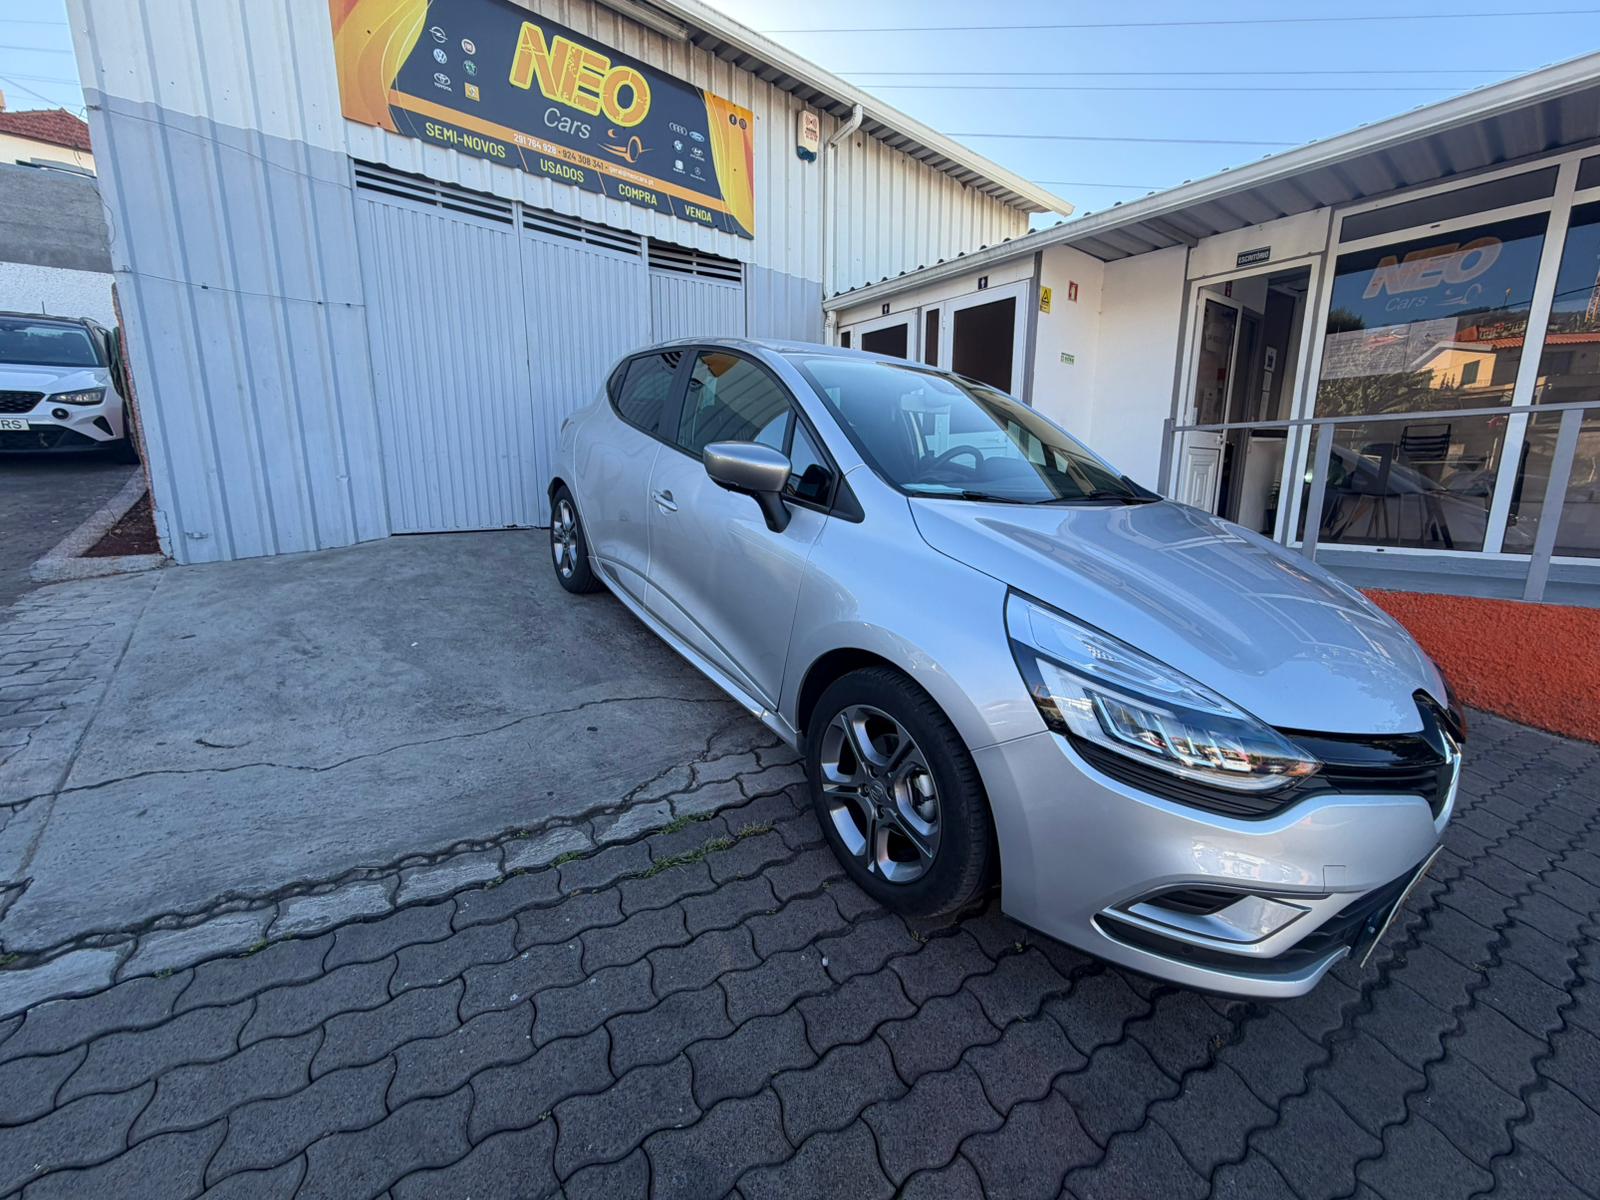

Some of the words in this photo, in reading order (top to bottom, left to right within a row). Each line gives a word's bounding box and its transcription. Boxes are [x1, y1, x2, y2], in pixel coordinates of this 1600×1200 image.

[508, 21, 651, 128] NEO
[544, 107, 592, 140] Cars
[425, 122, 506, 159] SEMI-NOVOS
[540, 158, 585, 183] USADOS
[618, 184, 658, 206] COMPRA
[684, 204, 713, 223] VENDA
[513, 133, 527, 145] 291
[528, 137, 542, 150] 764
[562, 149, 577, 162] 924
[577, 154, 592, 166] 308
[592, 158, 604, 170] 341
[1362, 236, 1503, 299] NEO
[1385, 296, 1429, 312] Cars
